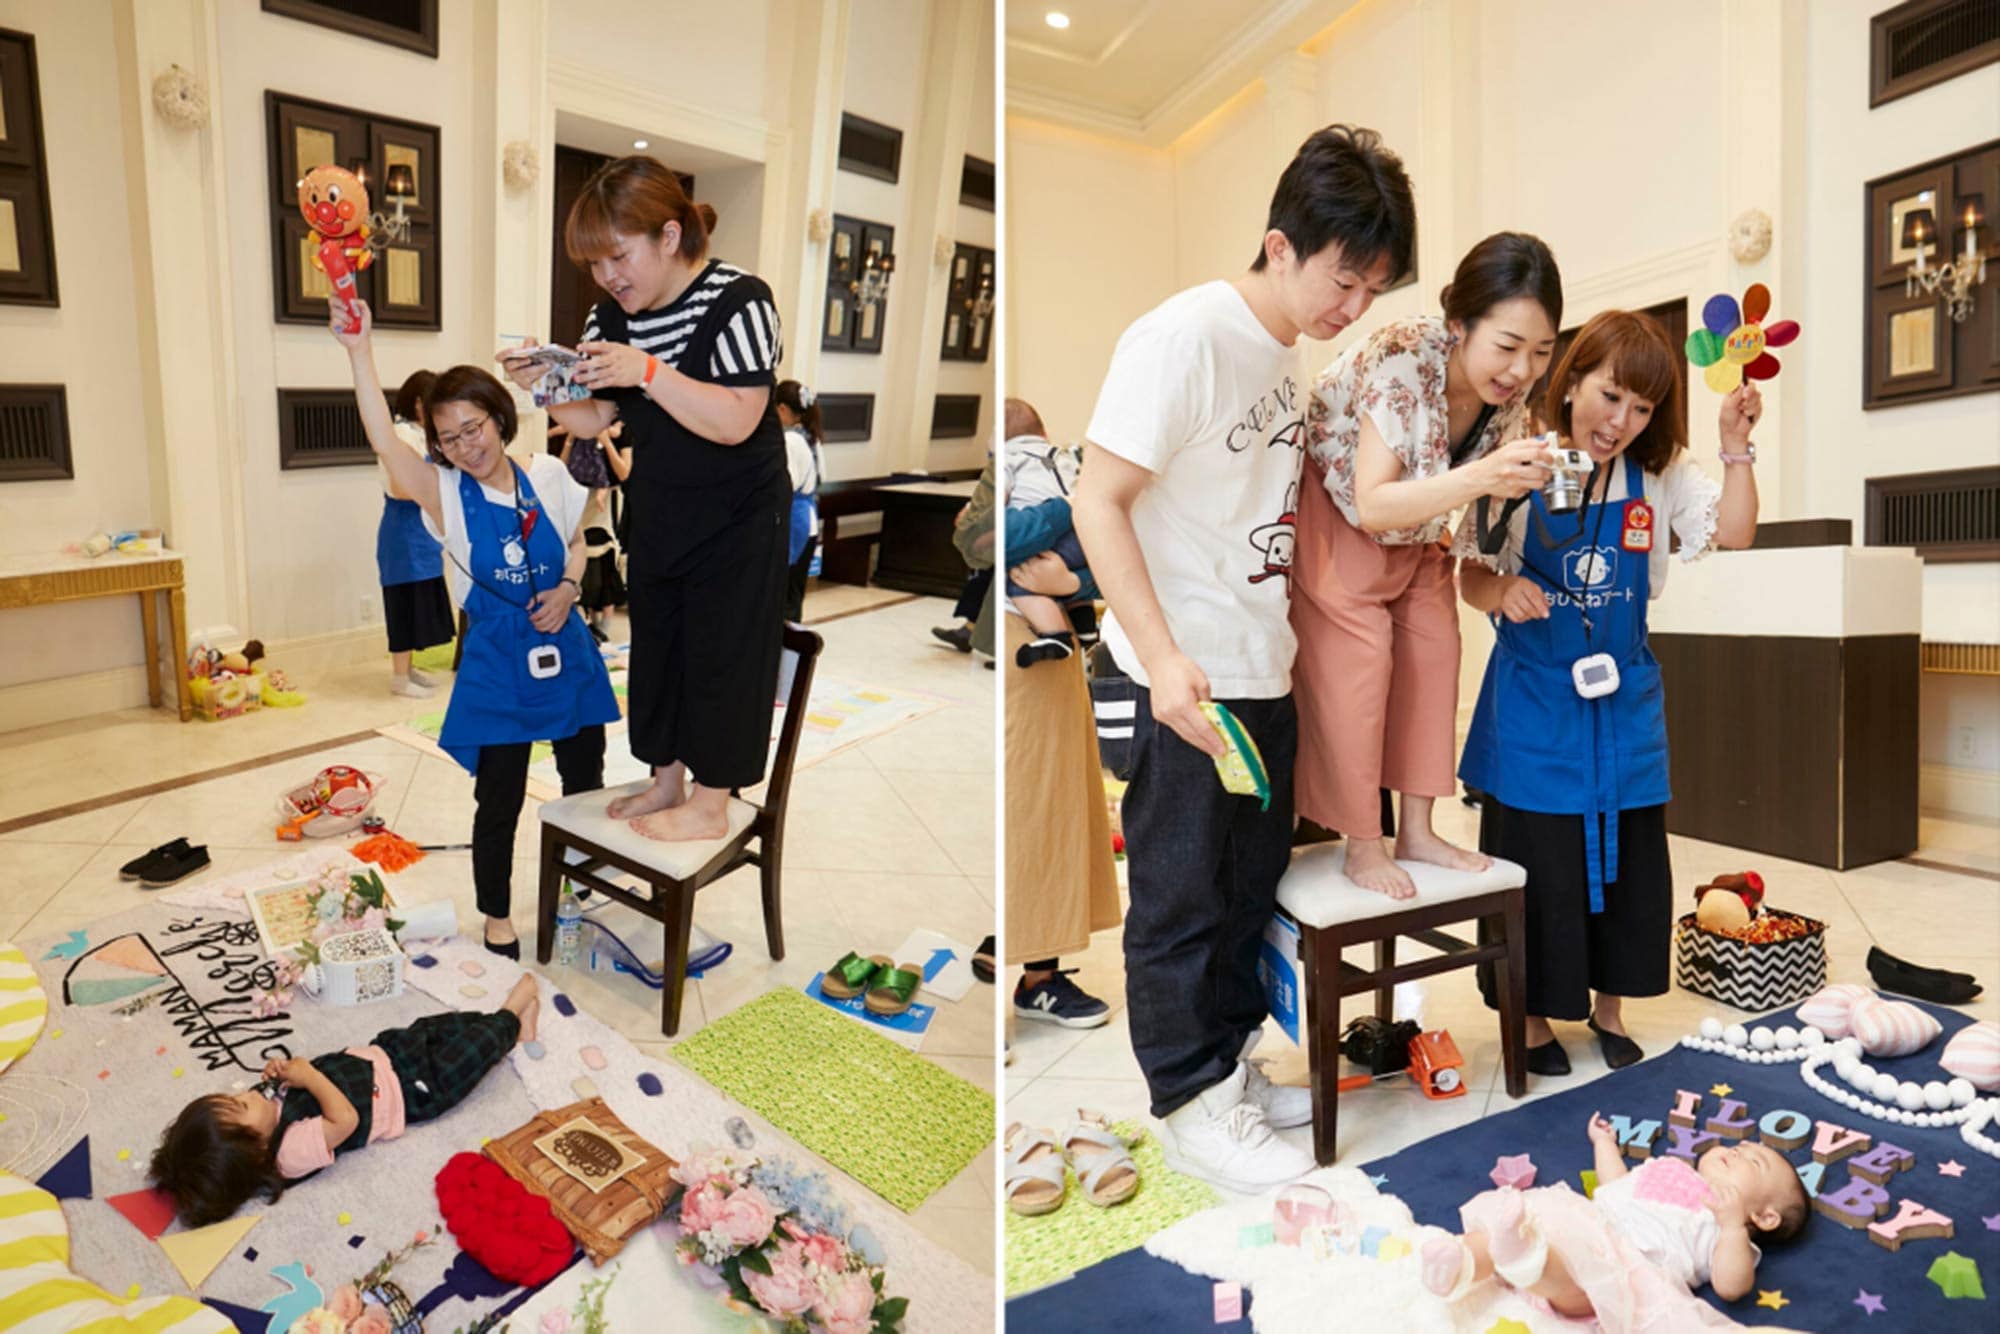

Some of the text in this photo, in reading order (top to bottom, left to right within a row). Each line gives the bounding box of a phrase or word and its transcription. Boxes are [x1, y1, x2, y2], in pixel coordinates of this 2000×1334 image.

[160, 983, 238, 1071] MAMAN
[1033, 991, 1058, 1012] N
[1669, 1089, 1914, 1178] I LOVE
[1609, 1115, 1954, 1246] MY ABY
